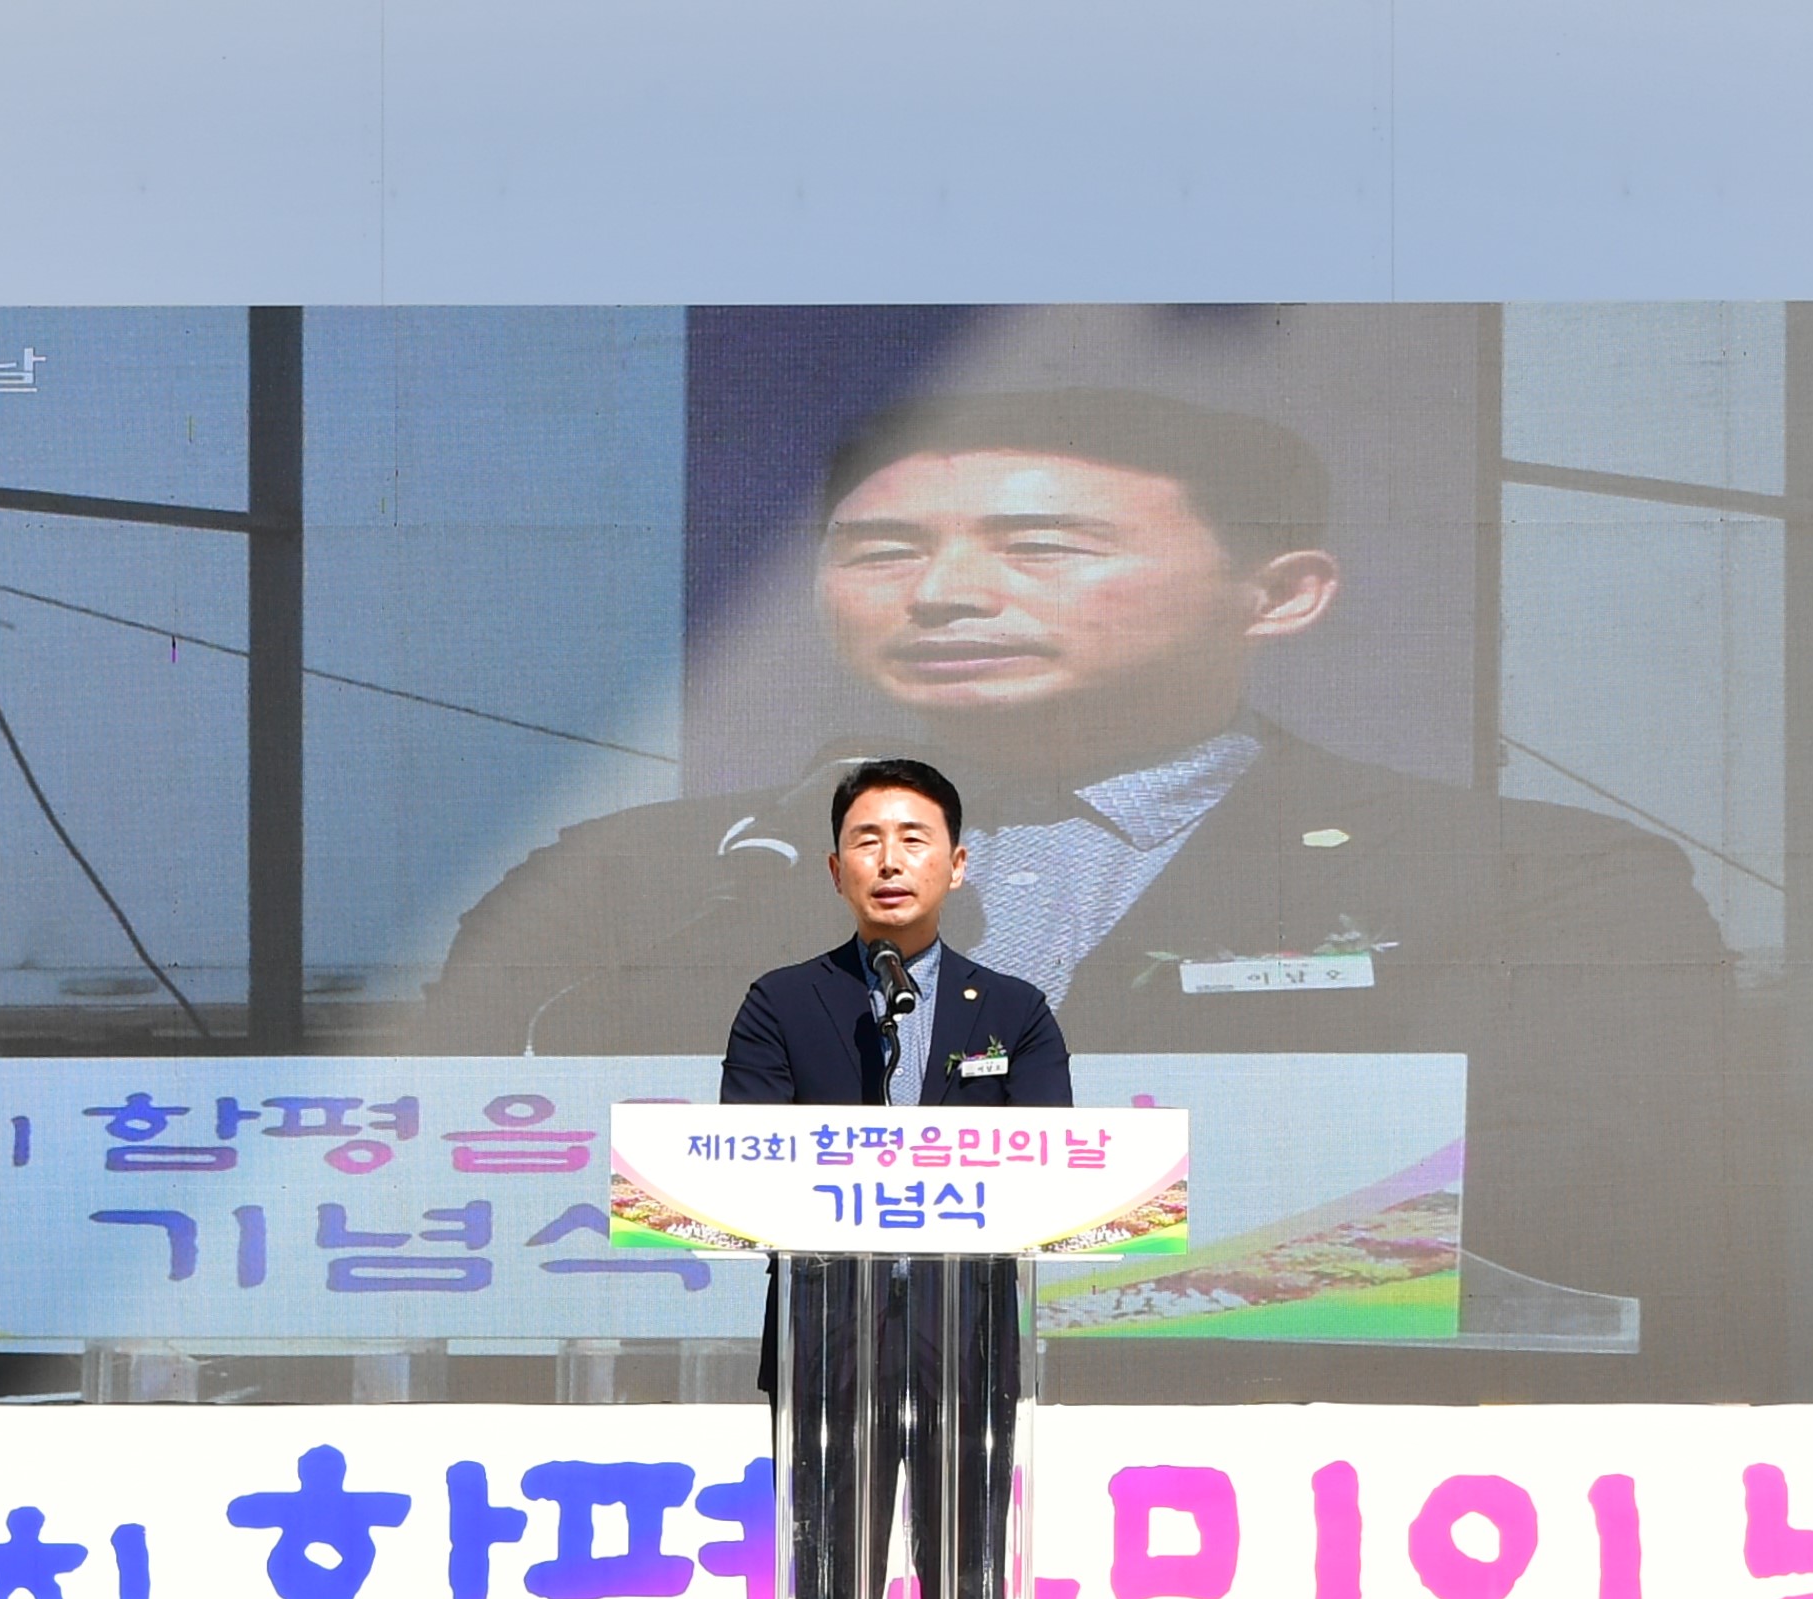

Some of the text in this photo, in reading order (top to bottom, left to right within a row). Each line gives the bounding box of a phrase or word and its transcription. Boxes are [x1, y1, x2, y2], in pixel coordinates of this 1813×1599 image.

[687, 1124, 1112, 1170] 제13회 함평읍민의 날
[813, 1181, 986, 1229] 기념식
